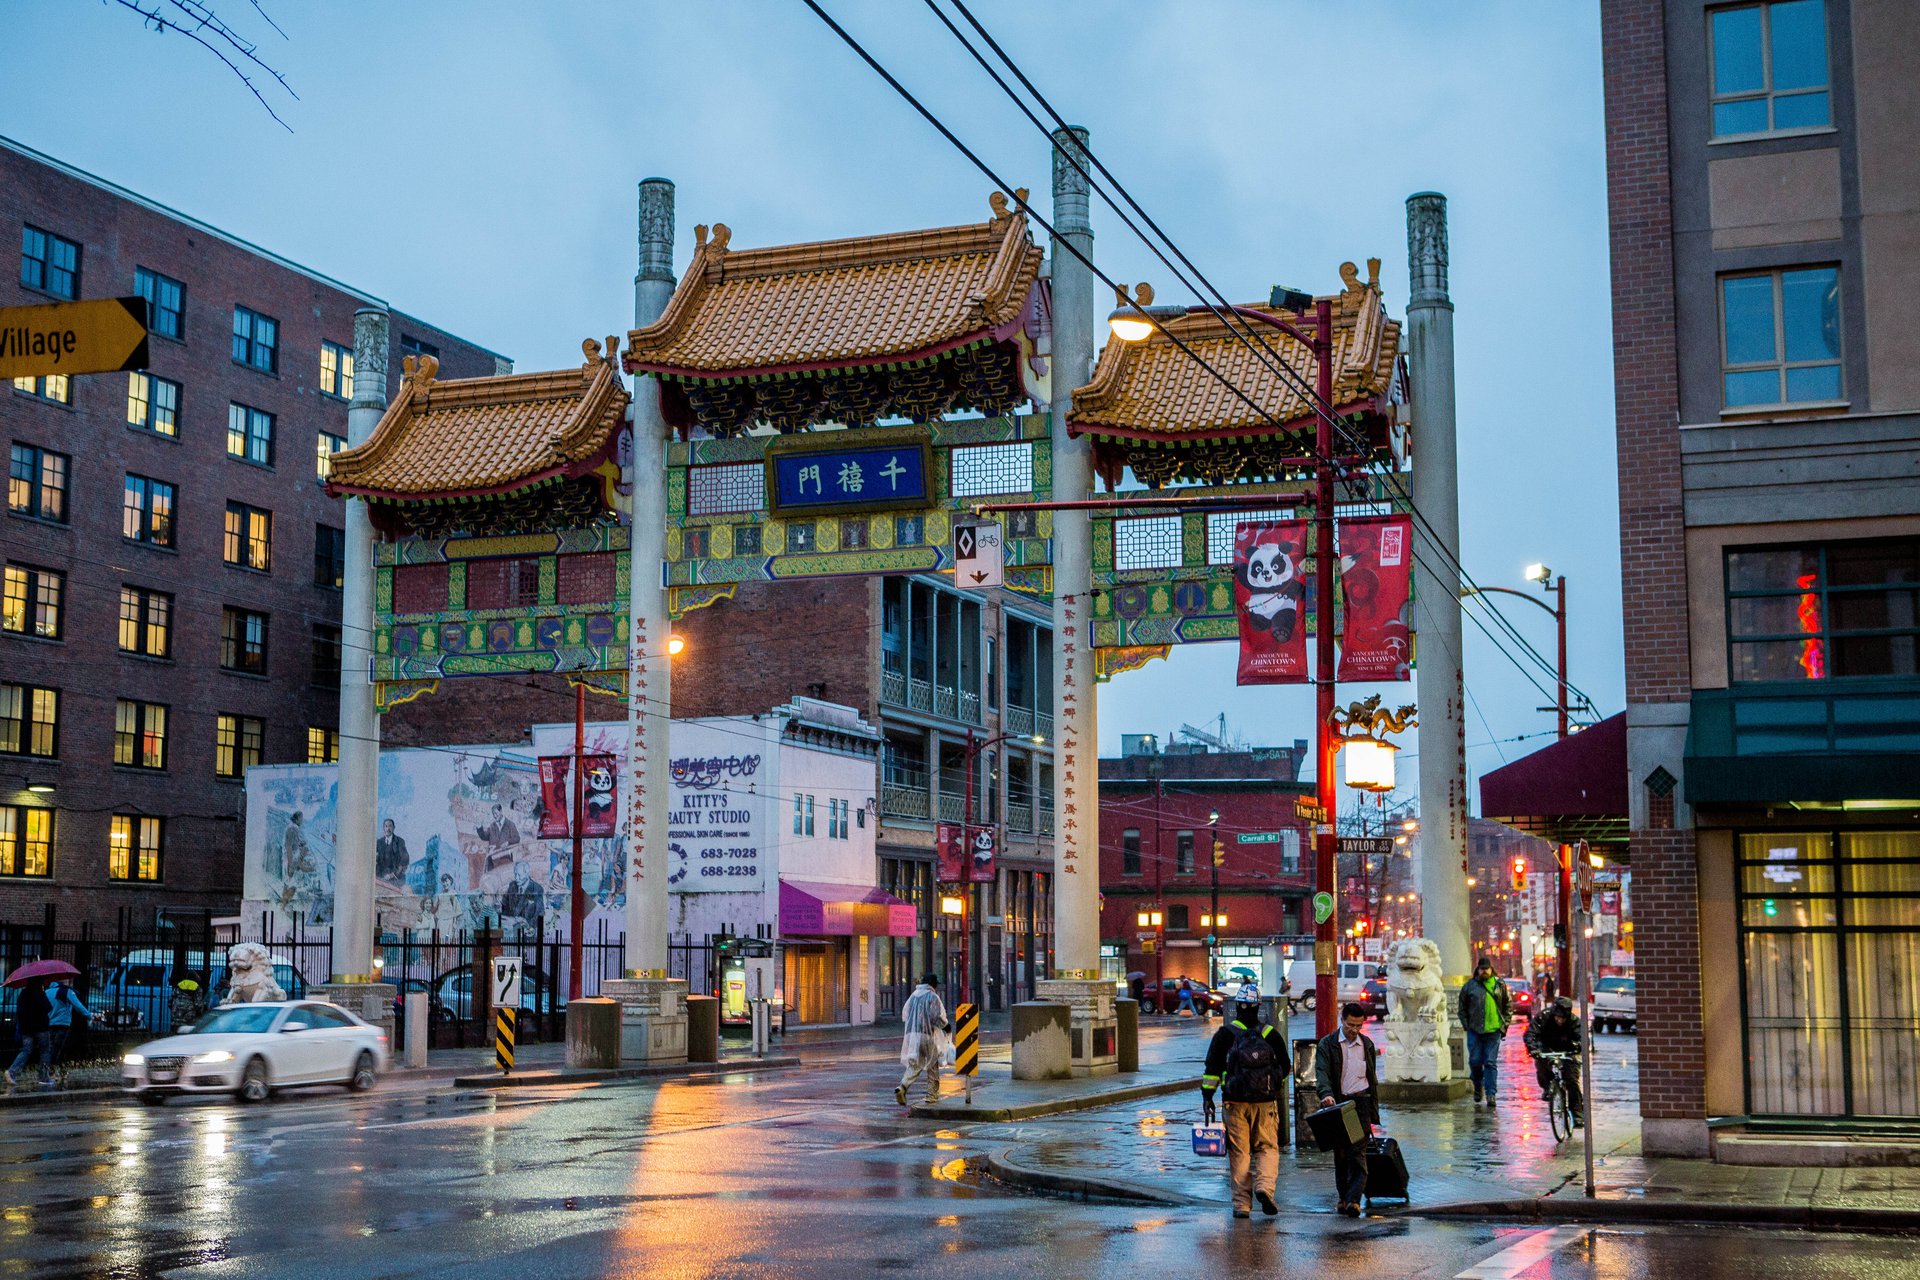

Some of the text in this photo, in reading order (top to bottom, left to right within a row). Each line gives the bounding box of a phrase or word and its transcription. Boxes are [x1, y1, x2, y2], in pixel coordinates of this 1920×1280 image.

[0, 327, 76, 364] Village
[799, 456, 906, 495] 千禧門
[1346, 655, 1396, 663] CHINATOWN
[683, 794, 728, 808] KITTY'S
[668, 810, 751, 824] EAUTY STUDIO
[697, 830, 708, 838] SKIN
[709, 829, 723, 838] CARE
[1241, 834, 1265, 842] Carrall
[1342, 839, 1375, 851] TAYLOR
[701, 848, 757, 859] 683-7028
[701, 866, 757, 876] 688-2238
